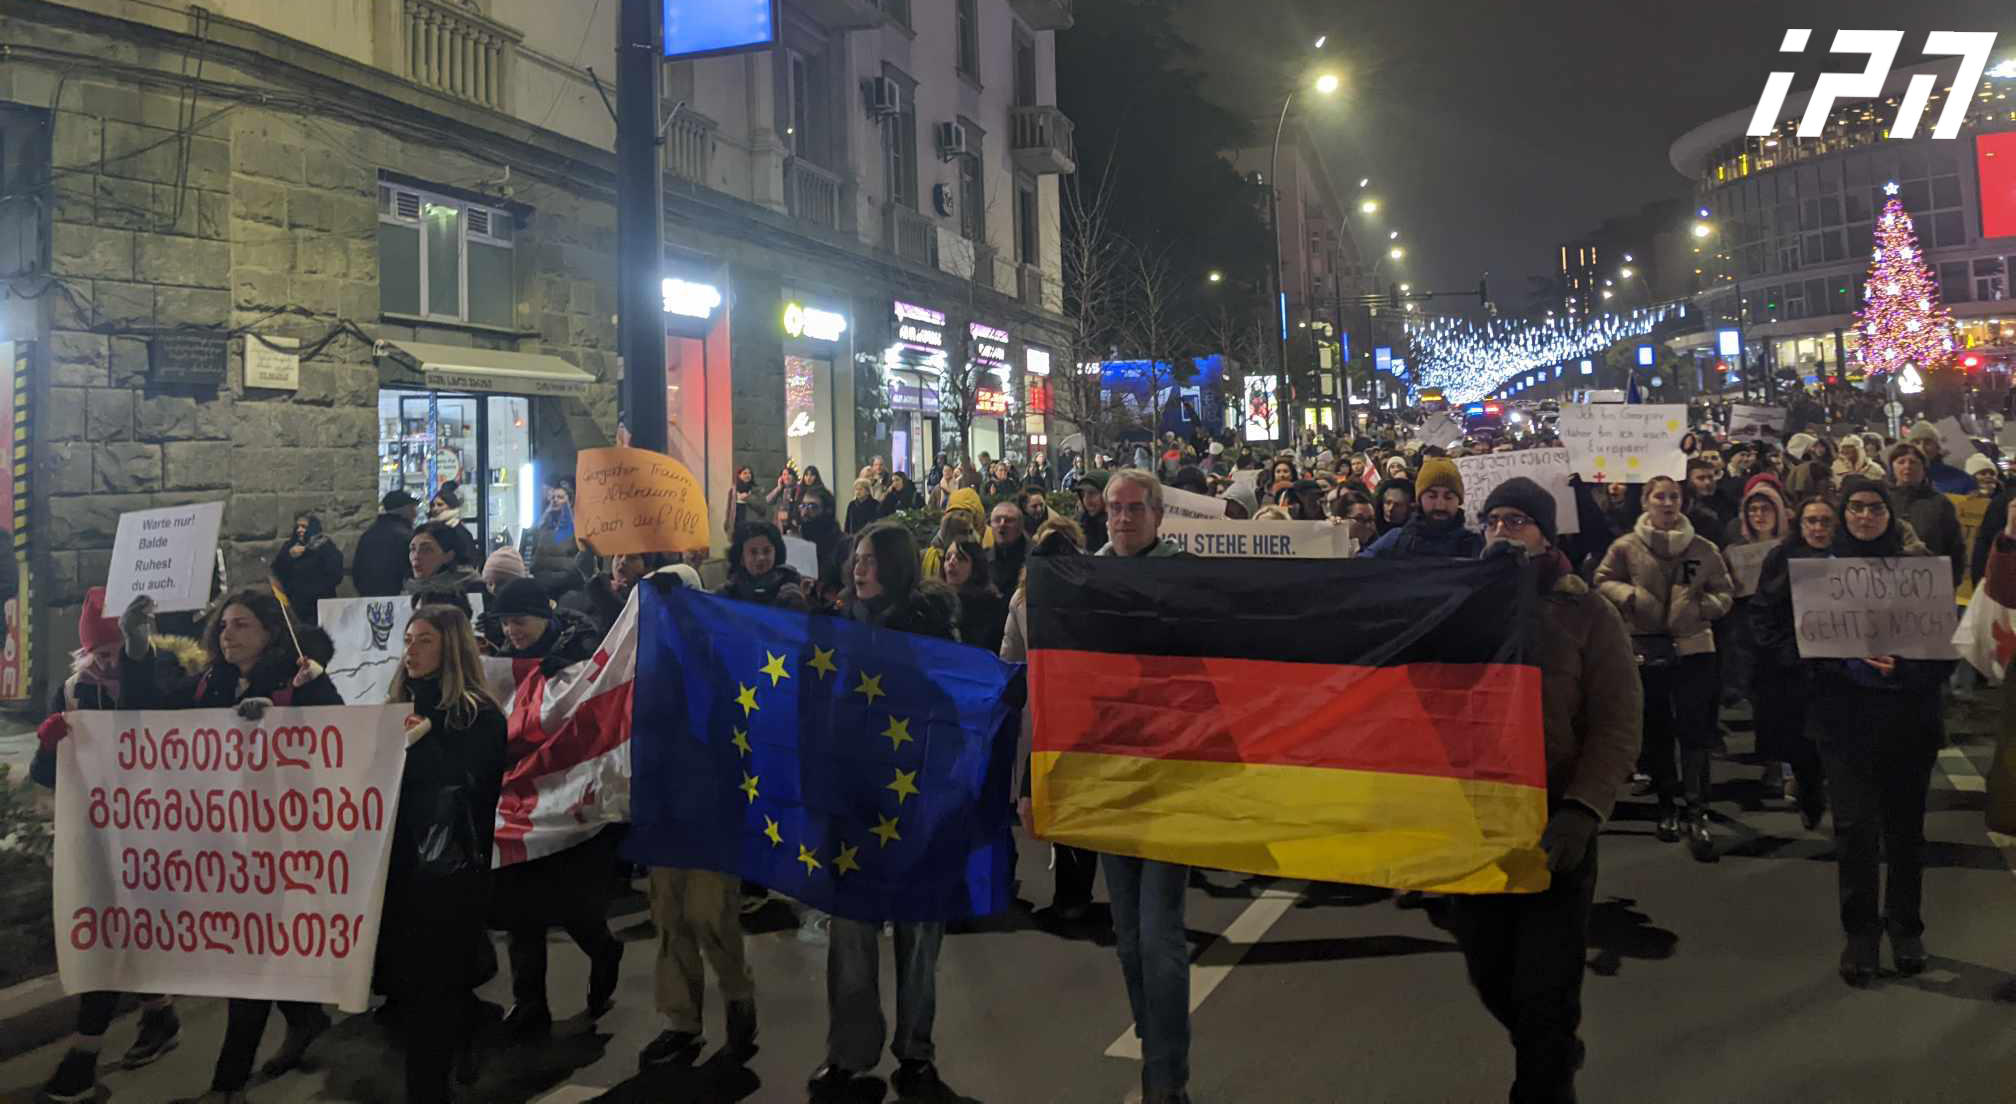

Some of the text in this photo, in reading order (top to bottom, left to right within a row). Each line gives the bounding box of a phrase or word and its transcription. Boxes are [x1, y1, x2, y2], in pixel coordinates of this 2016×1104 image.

[142, 513, 196, 531] Warte nur!
[138, 536, 169, 551] Balde
[1194, 534, 1247, 555] STEHE
[1252, 534, 1297, 556] HIER.
[134, 557, 173, 572] Ruhest
[1683, 559, 1701, 584] F
[131, 577, 177, 592] du auch.
[117, 725, 344, 772] ქართველი
[88, 786, 385, 833] გერმანისტები
[121, 847, 350, 896] ევროპული
[69, 906, 365, 959] მომავლისთვ
